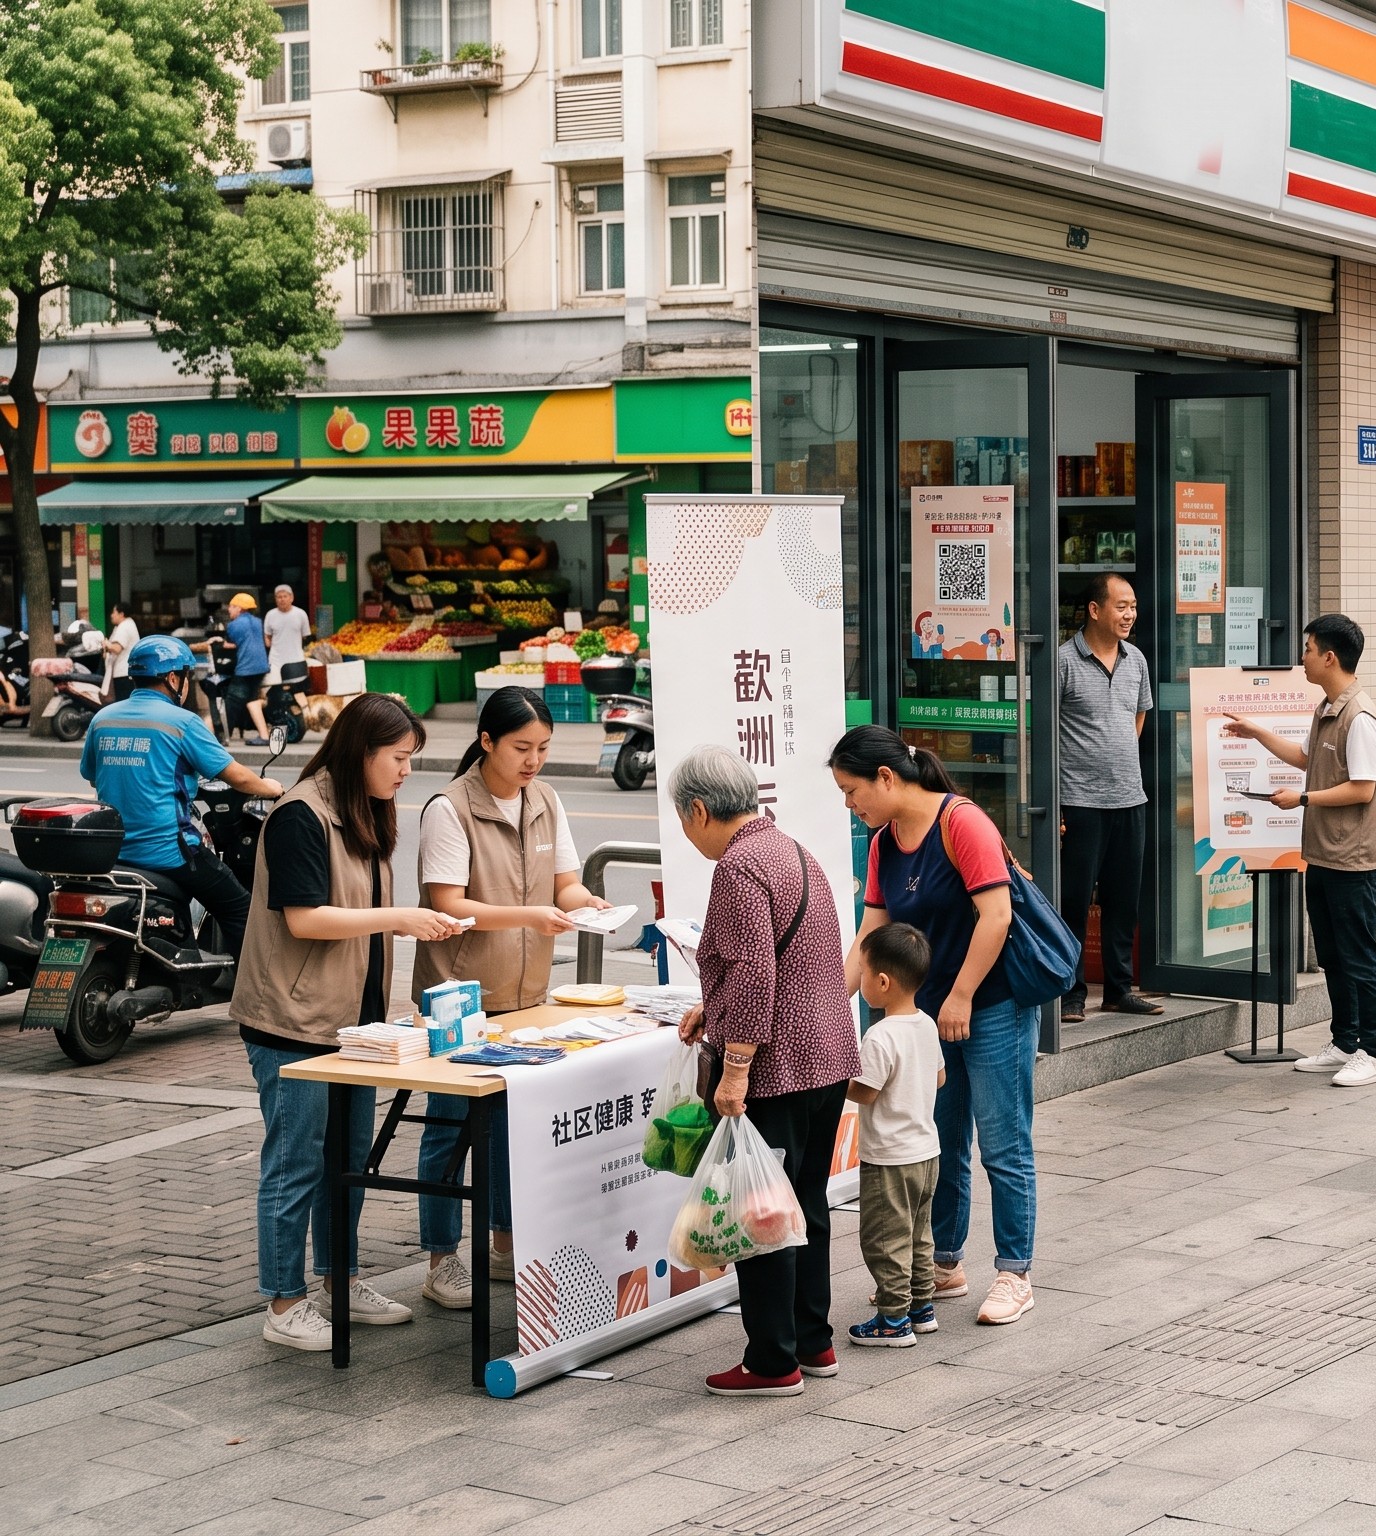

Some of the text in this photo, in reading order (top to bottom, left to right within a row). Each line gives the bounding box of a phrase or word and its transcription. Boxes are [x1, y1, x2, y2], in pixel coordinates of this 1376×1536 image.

[383, 404, 505, 448] 果果蔬
[552, 1094, 633, 1147] 社区健康
